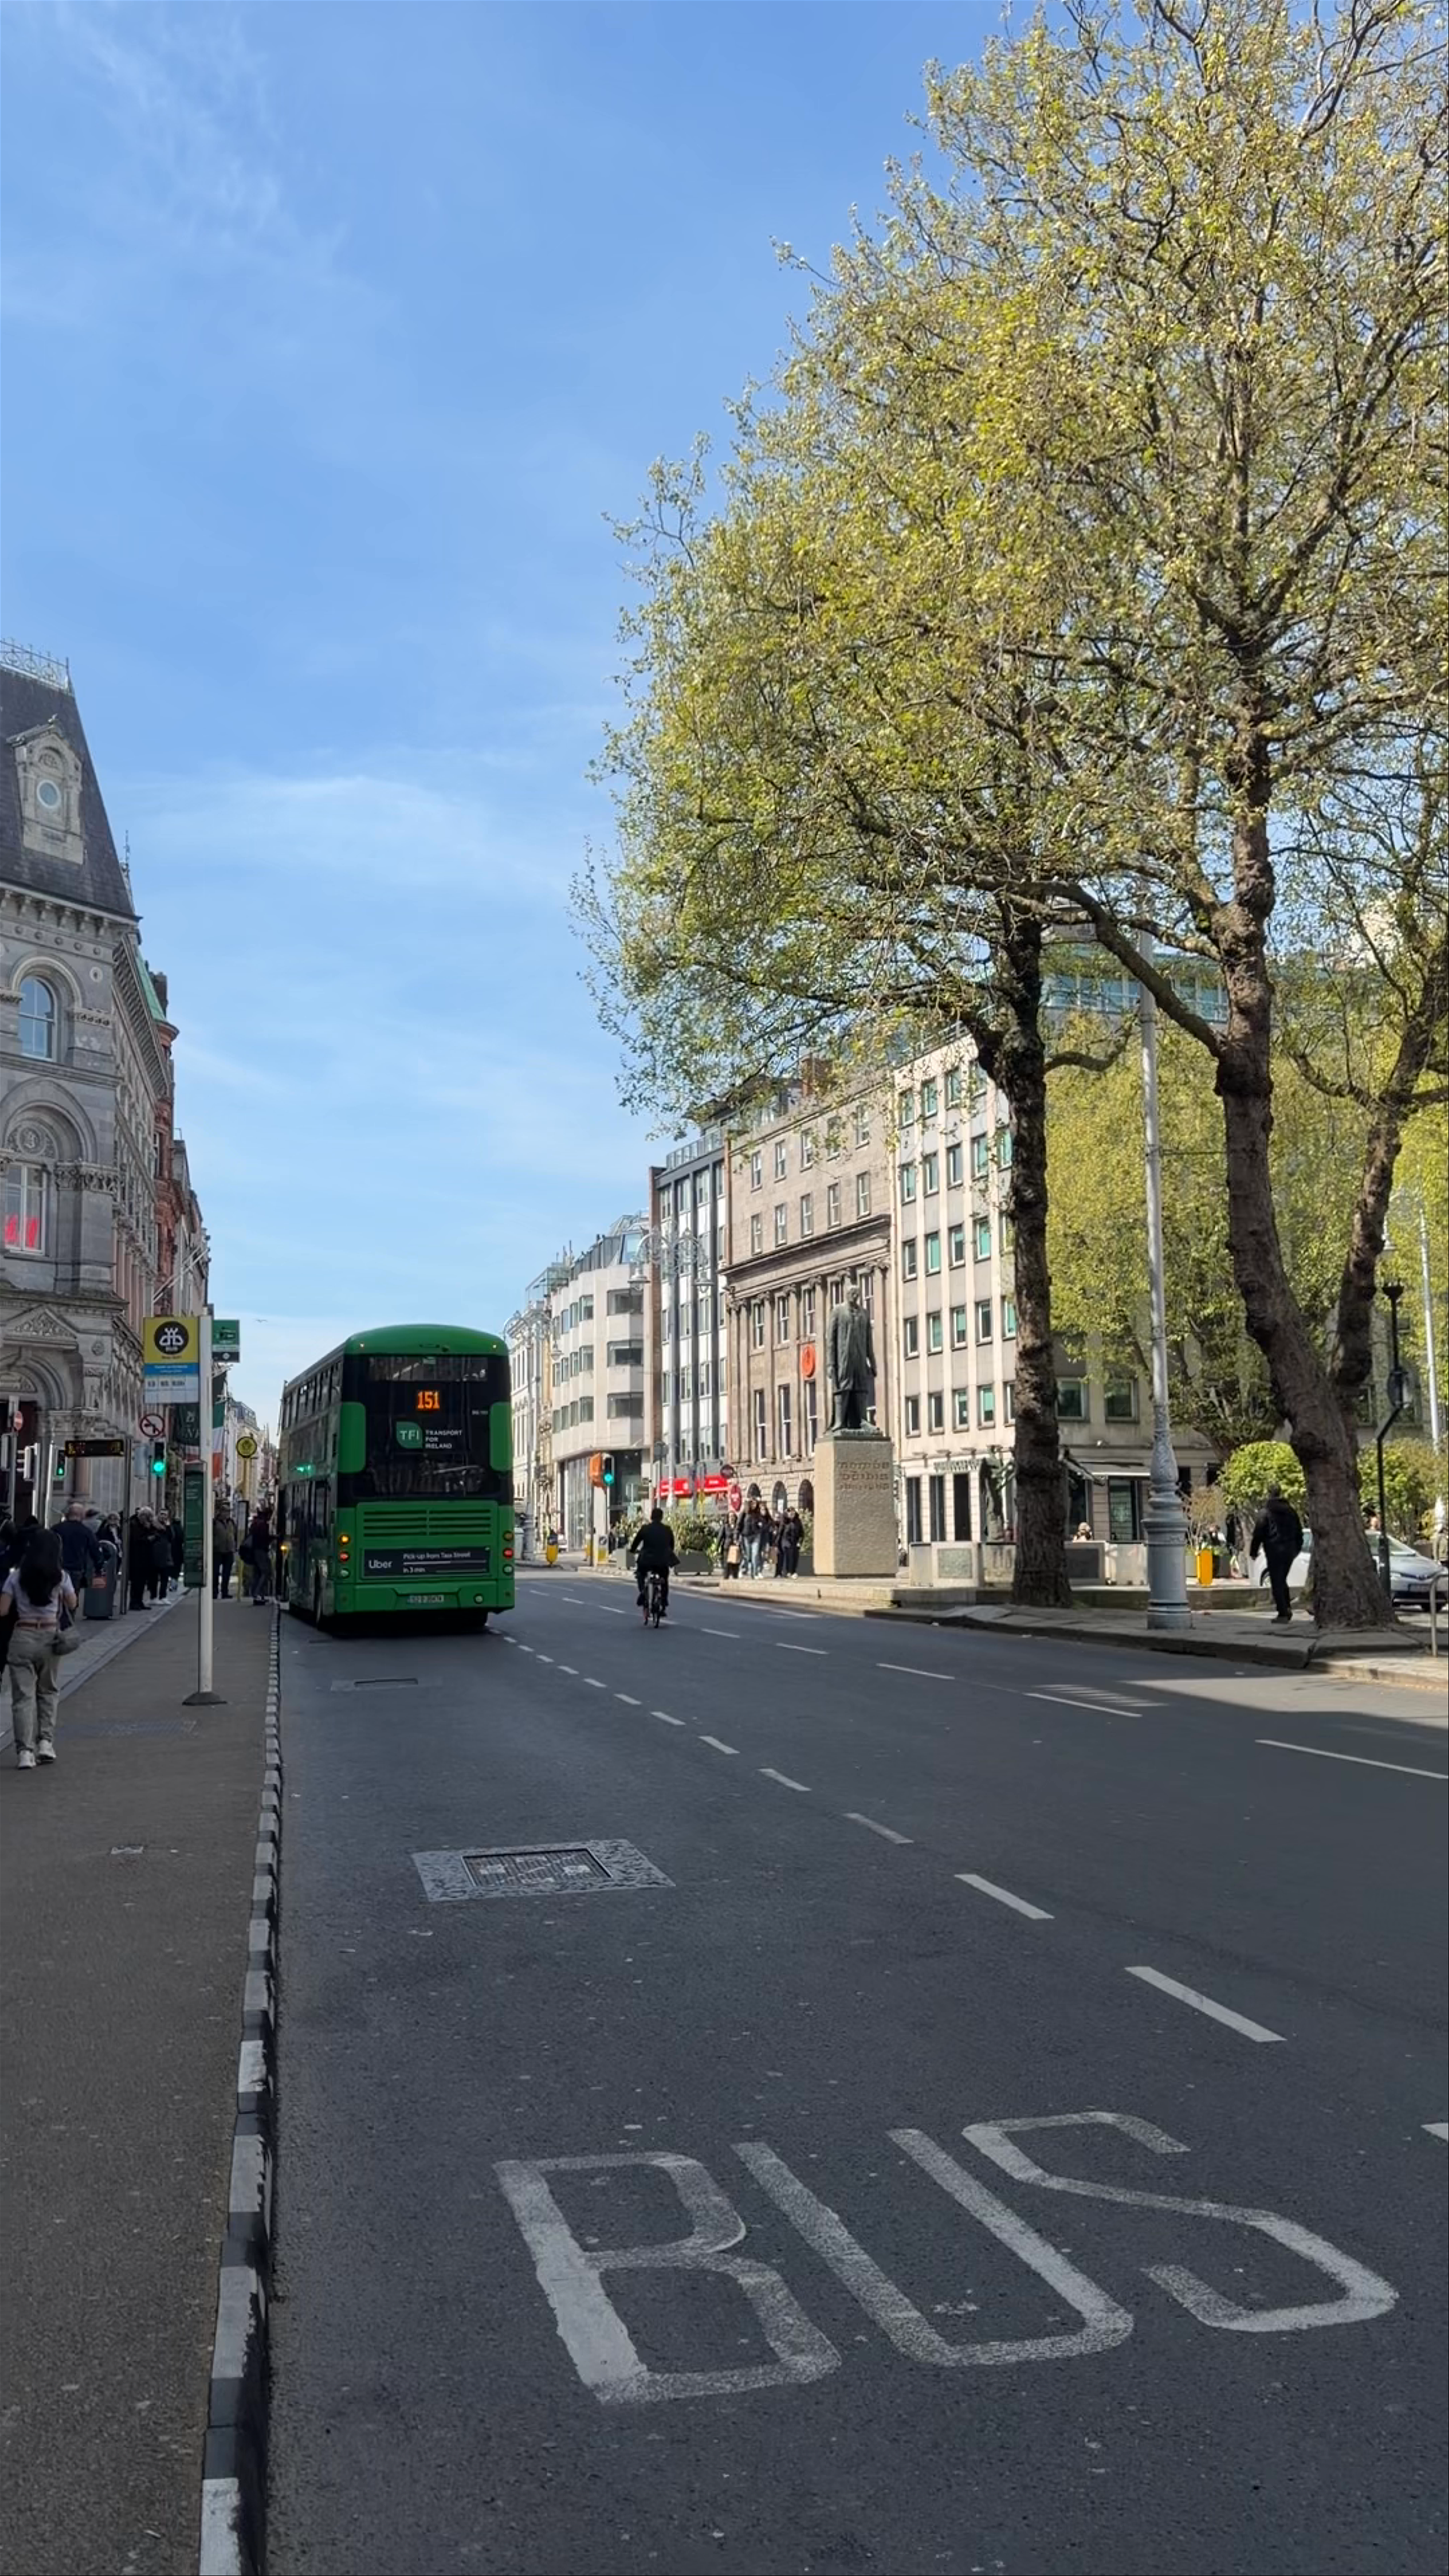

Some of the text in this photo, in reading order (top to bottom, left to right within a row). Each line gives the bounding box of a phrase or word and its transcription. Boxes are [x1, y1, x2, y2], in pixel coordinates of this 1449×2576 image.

[417, 1391, 440, 1409] 151
[400, 1430, 419, 1440] TFI
[368, 1559, 392, 1569] Uber
[492, 2110, 1399, 2404] BUS
